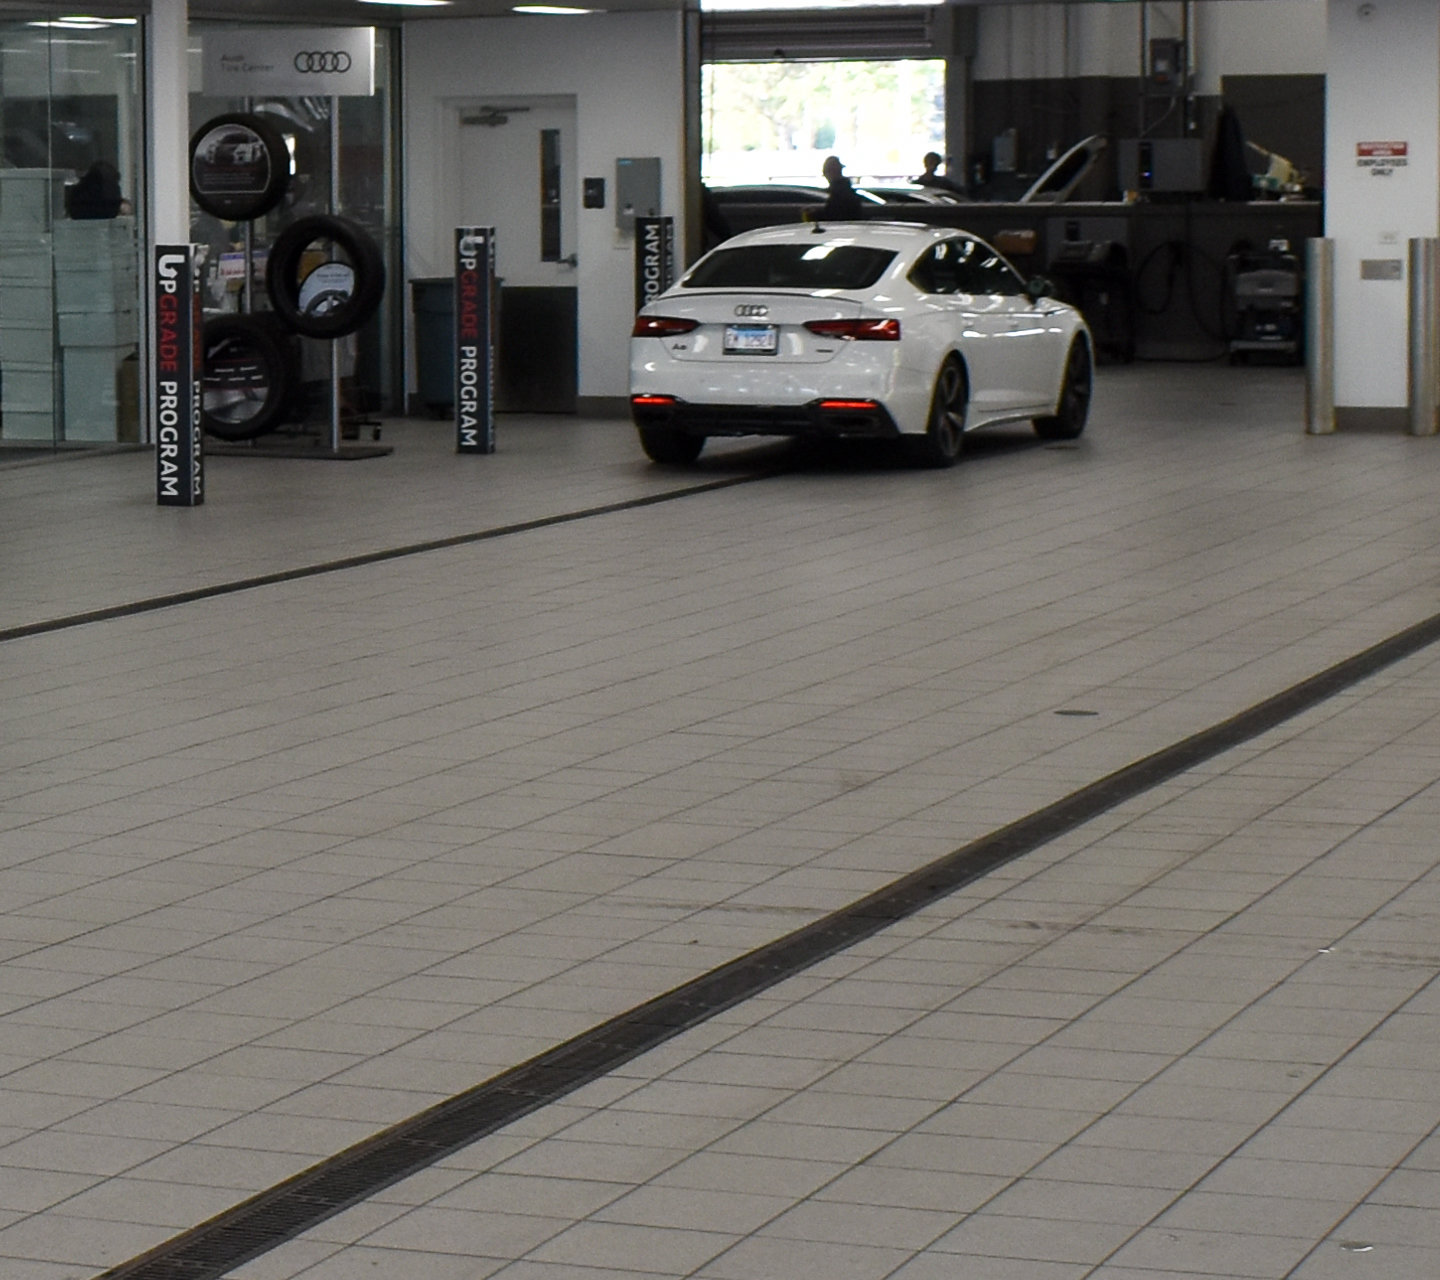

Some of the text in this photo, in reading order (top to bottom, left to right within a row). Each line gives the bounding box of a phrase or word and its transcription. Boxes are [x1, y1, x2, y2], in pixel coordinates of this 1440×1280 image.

[644, 224, 660, 306] ROGRAM
[158, 253, 185, 497] UPGRADE PROGRAM
[460, 346, 477, 447] PROGRAM
